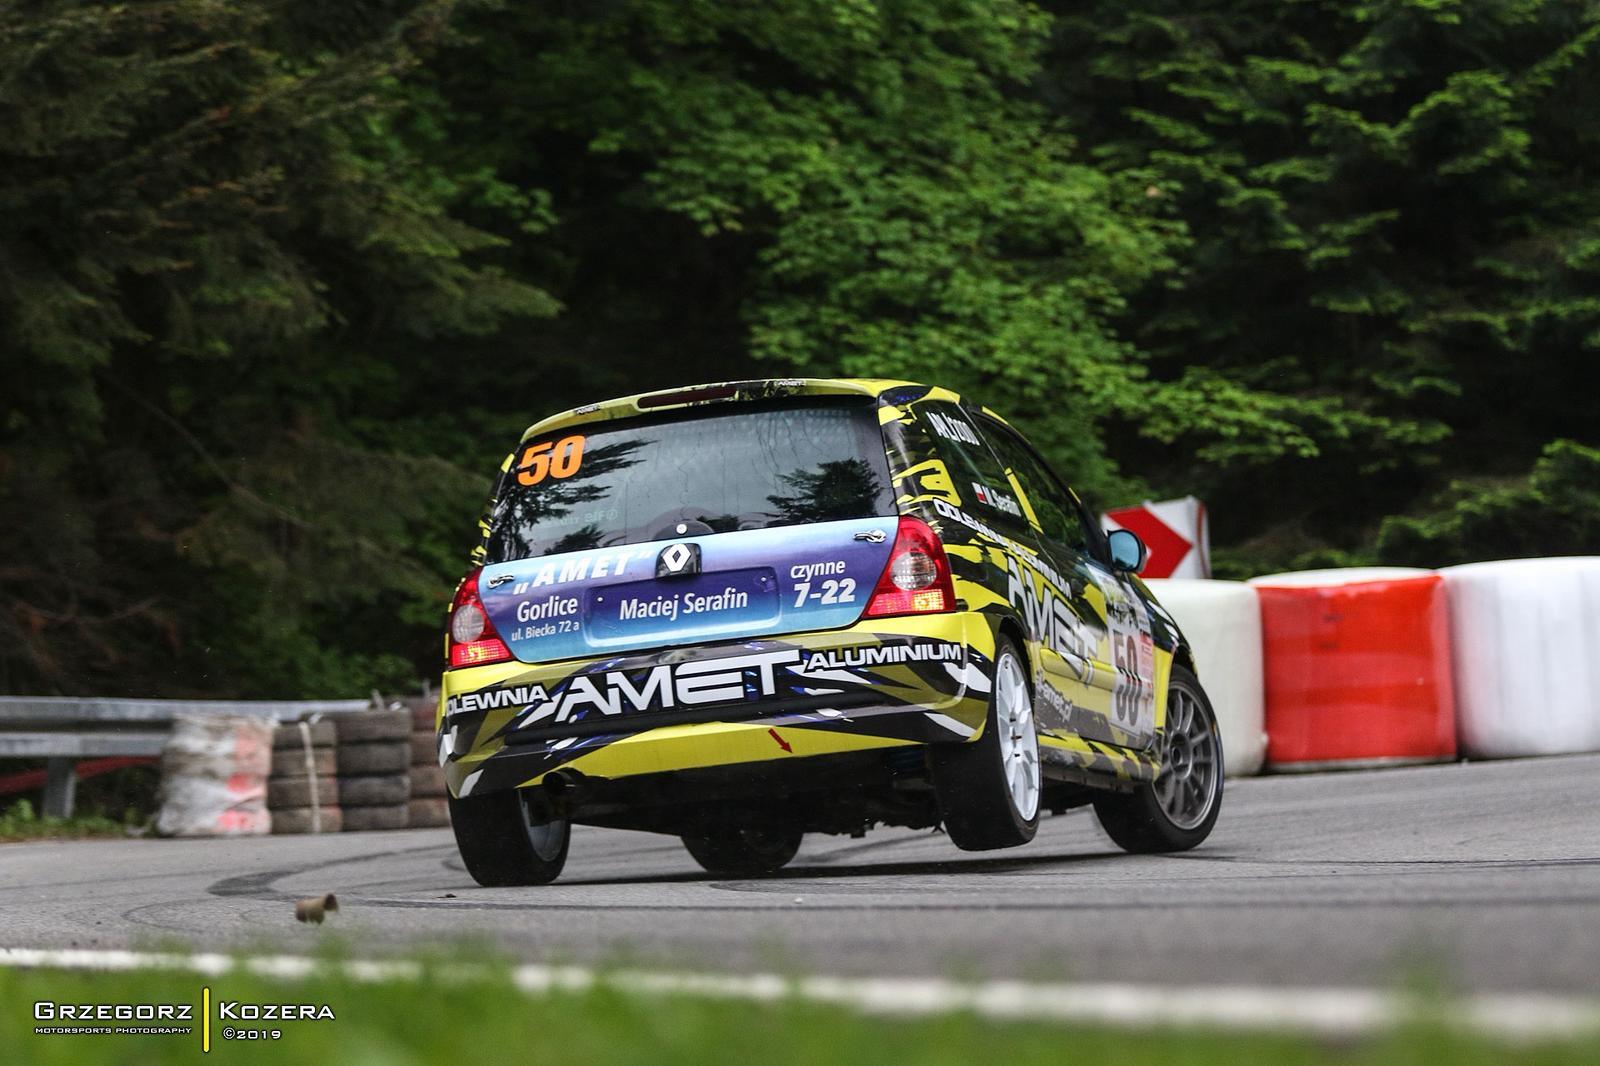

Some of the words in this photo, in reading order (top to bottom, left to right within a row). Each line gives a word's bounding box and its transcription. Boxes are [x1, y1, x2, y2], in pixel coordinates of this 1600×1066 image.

[517, 435, 586, 486] 50
[790, 560, 846, 583] czynne
[517, 595, 578, 622] Gorlice
[619, 594, 679, 621] Maciej
[682, 588, 748, 614] Serafin
[793, 578, 857, 608] 7-22
[511, 627, 523, 641] ul.
[525, 622, 557, 639] Biecka
[558, 620, 571, 633] 72
[573, 621, 580, 631] a
[446, 685, 549, 717] DLEWNIA
[554, 649, 800, 723] AMET
[807, 643, 963, 671] ALUMINIUM
[1112, 629, 1142, 726] 50
